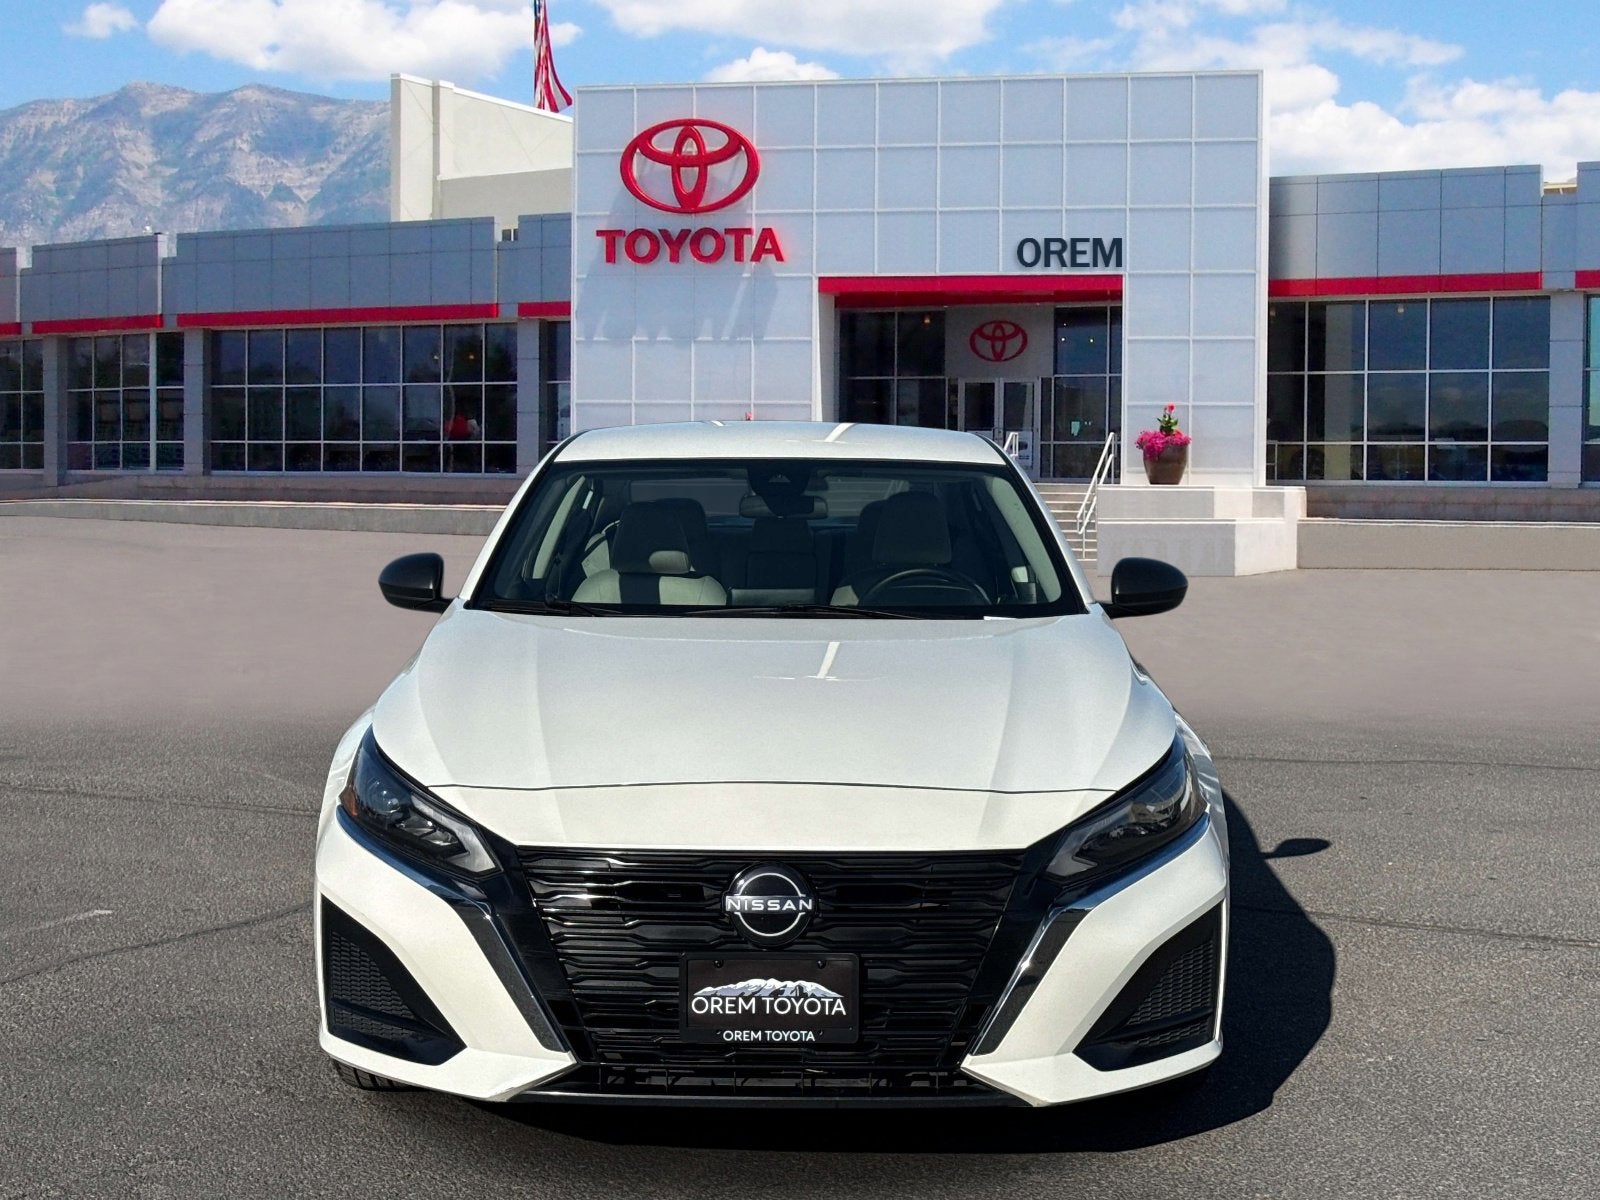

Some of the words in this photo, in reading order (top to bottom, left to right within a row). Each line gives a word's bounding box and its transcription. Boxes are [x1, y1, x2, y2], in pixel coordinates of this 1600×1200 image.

[596, 227, 785, 264] TOYOTA
[1016, 237, 1123, 268] OREM
[726, 898, 813, 911] NISSAN
[691, 996, 756, 1015] OREM
[762, 996, 846, 1016] TOYOTA
[722, 1030, 762, 1042] OREM
[764, 1030, 815, 1042] TOYOTA
